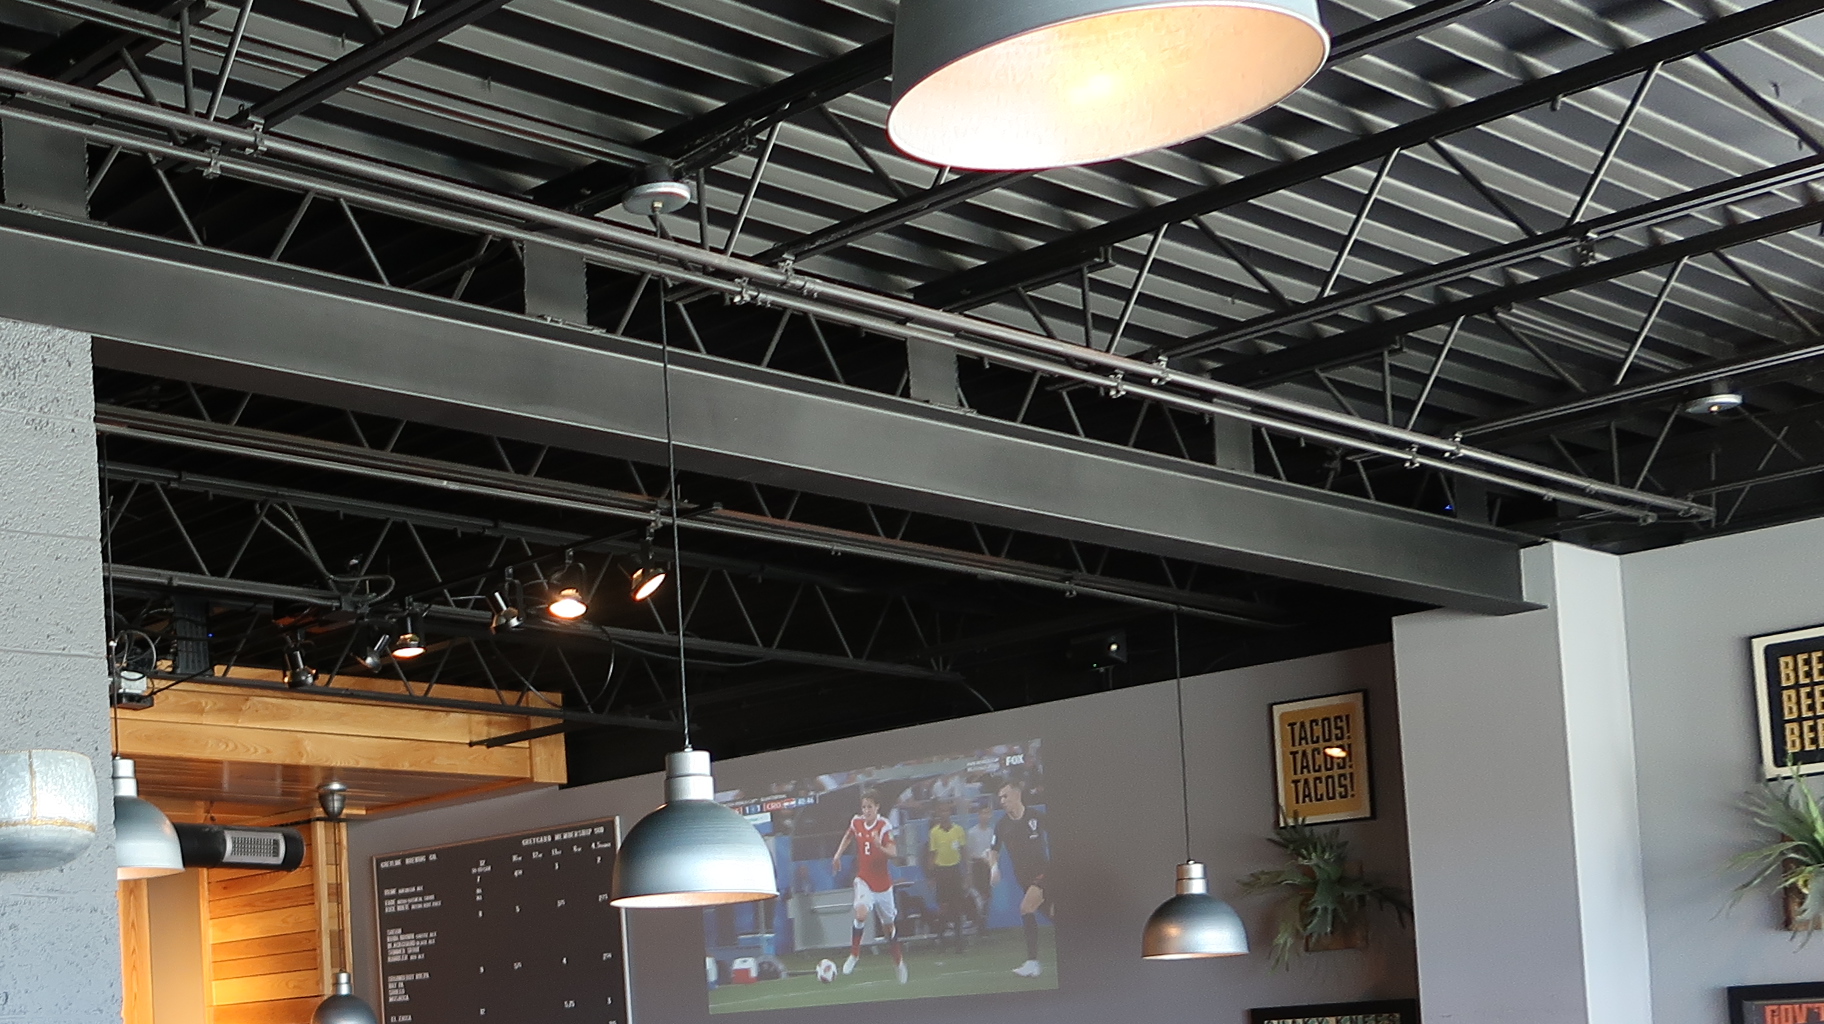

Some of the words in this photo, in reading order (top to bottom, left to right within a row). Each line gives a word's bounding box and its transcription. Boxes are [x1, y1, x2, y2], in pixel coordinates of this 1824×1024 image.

[1287, 714, 1351, 747] TACOS!
[1005, 754, 1024, 766] FOX
[1289, 743, 1353, 775] TACOS!
[1291, 772, 1355, 804] TACOS!
